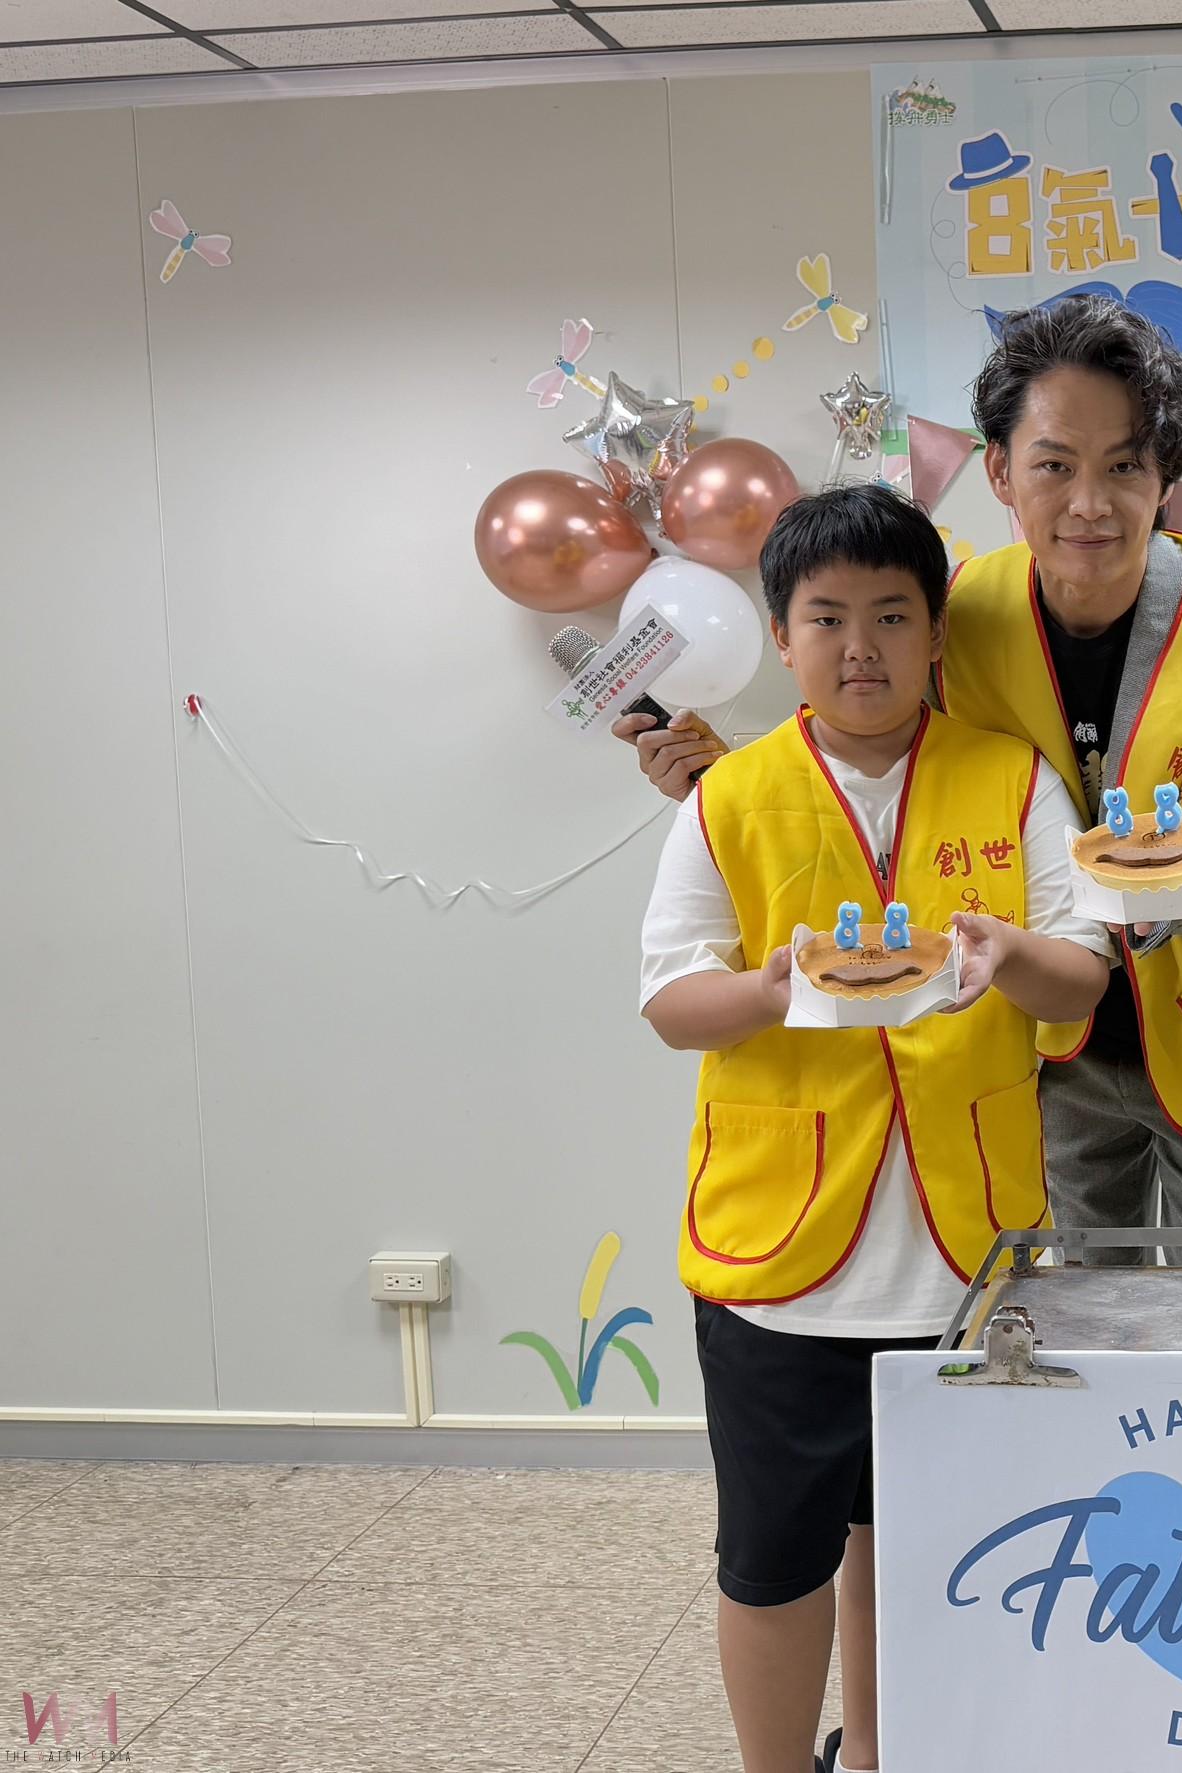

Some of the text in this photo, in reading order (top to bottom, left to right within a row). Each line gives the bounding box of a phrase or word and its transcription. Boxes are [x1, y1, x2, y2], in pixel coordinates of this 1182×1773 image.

[578, 616, 660, 699] 創世社會福利基金會
[588, 682, 608, 702] Genesis
[605, 668, 622, 684] Social
[619, 650, 639, 671] Welfare
[636, 625, 664, 653] Foundation
[933, 836, 1016, 879] 創世
